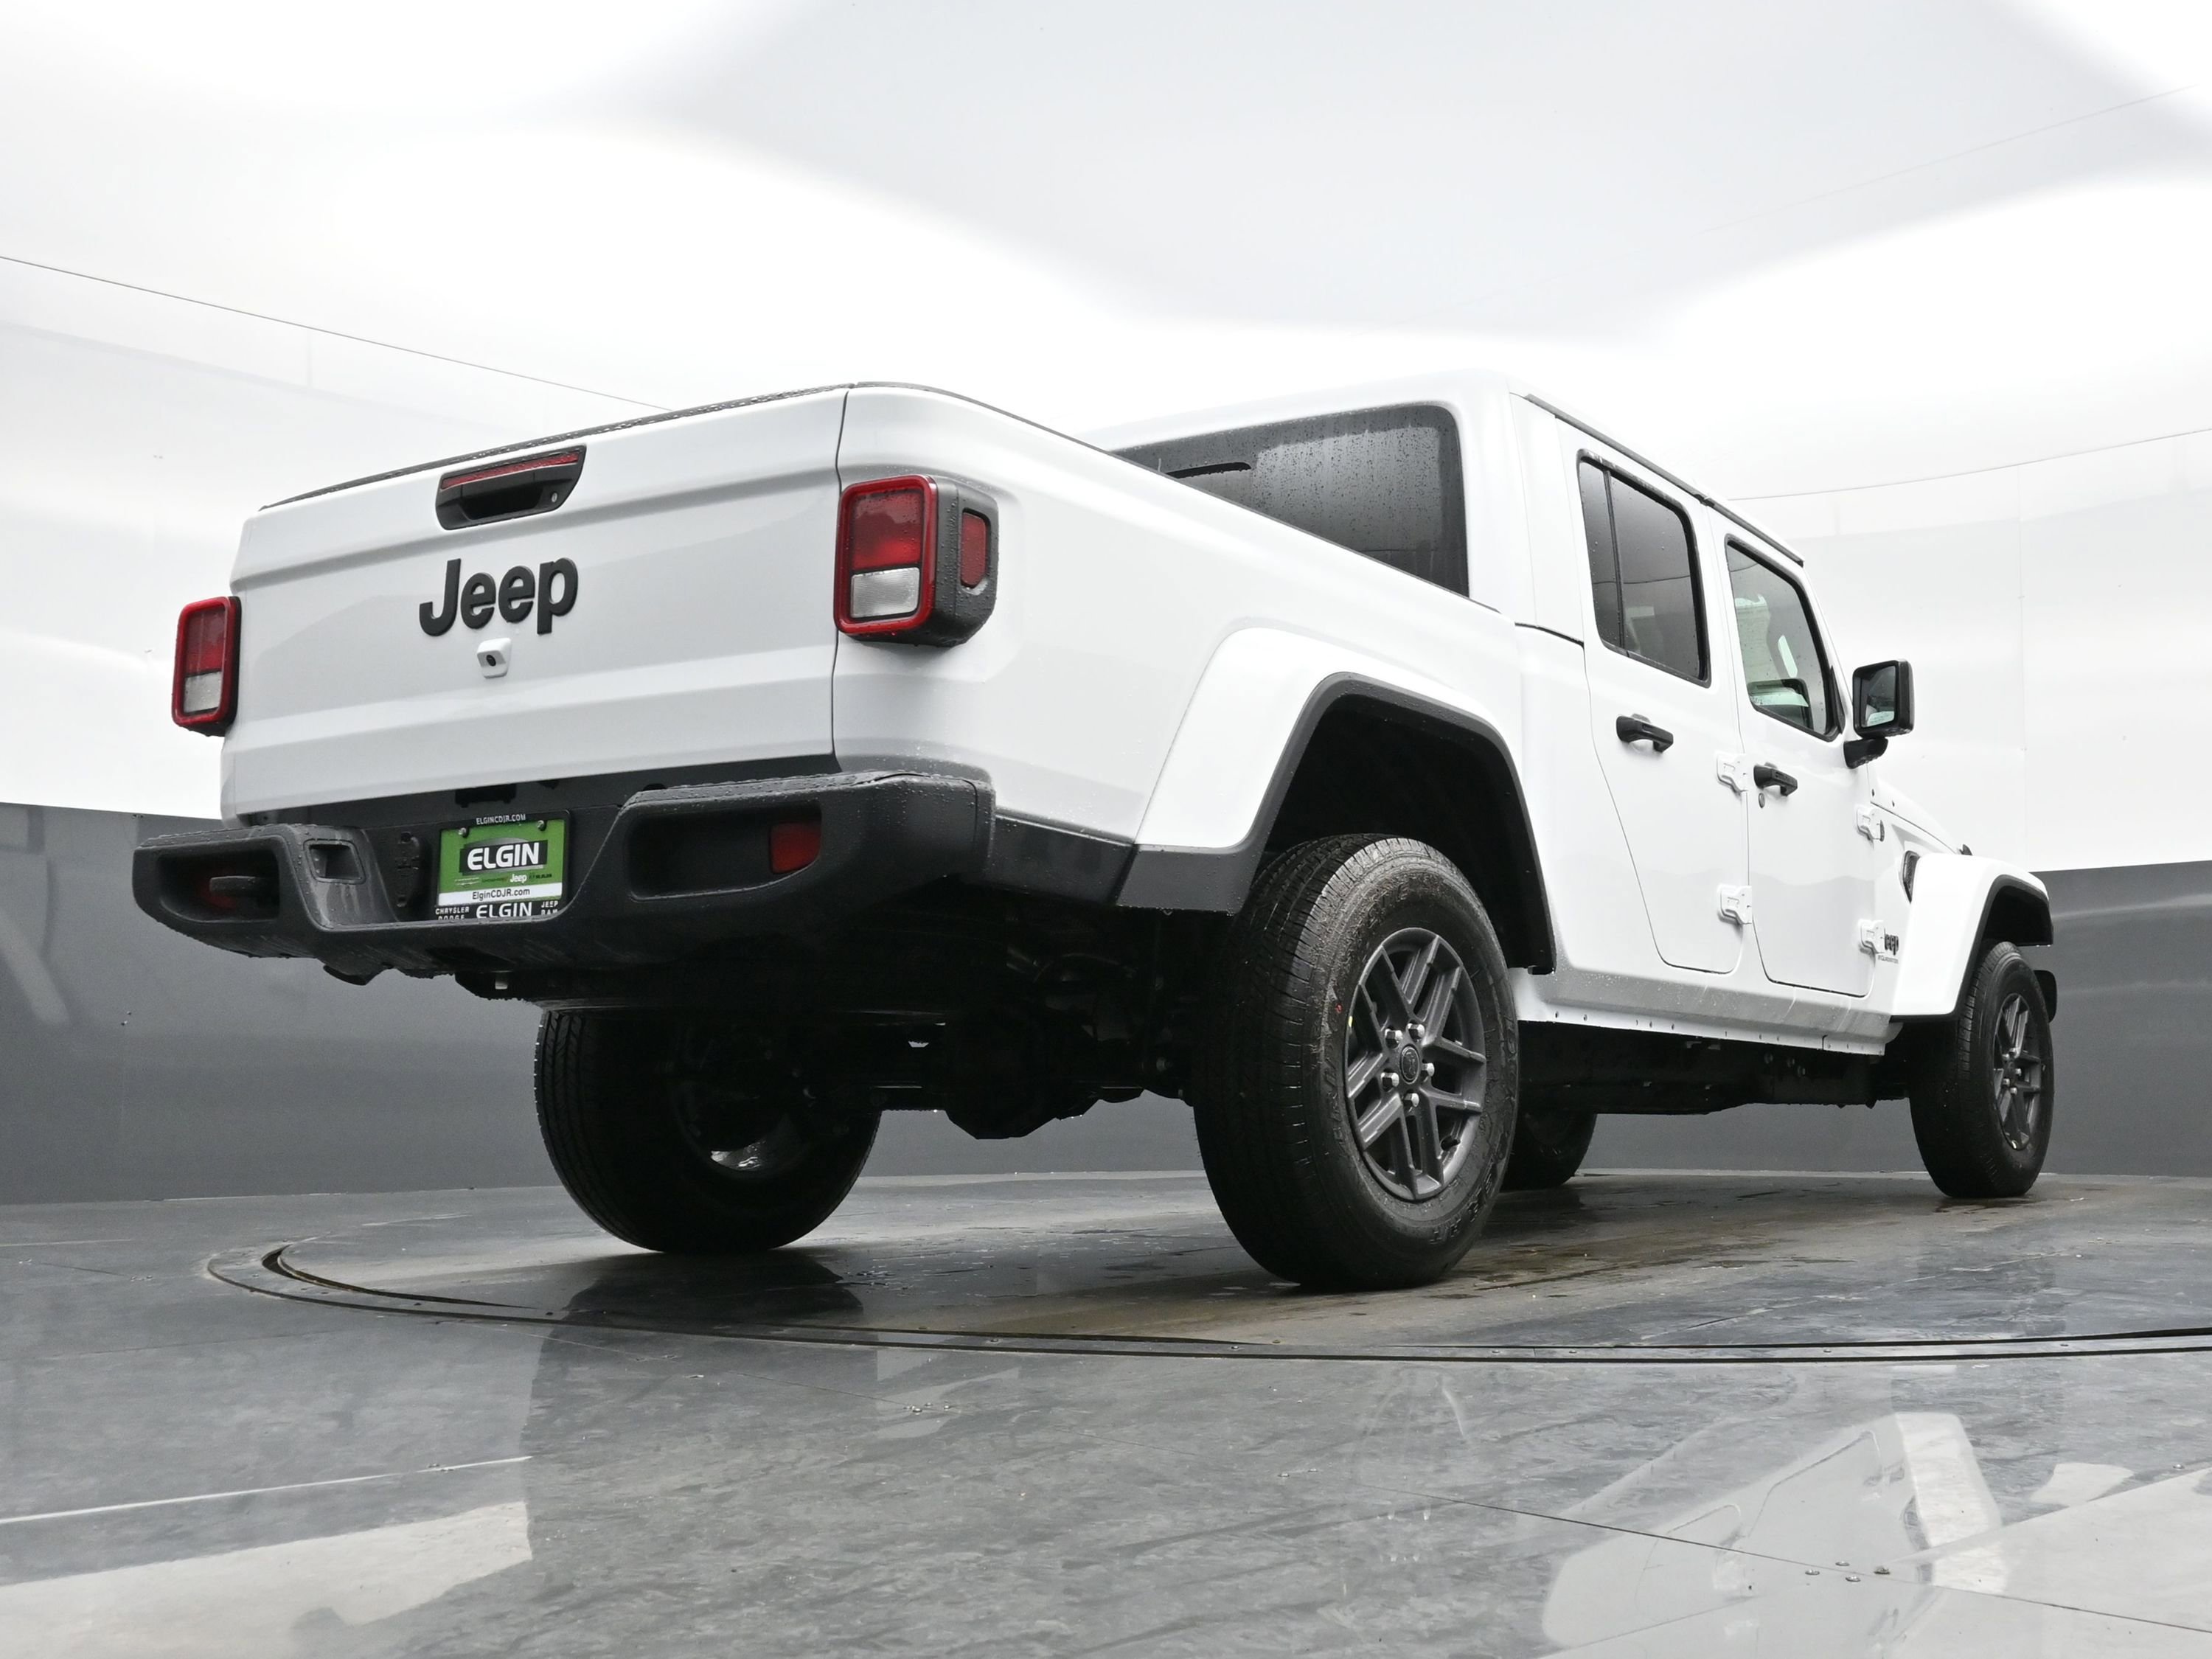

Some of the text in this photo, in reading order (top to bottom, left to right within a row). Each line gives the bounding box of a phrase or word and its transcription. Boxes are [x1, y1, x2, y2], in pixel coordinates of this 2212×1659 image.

[420, 557, 579, 636] Jeep
[476, 814, 526, 825] ELGINCDJR.COM
[467, 842, 540, 871] ELGIN
[509, 873, 527, 884] Jeep
[472, 888, 530, 901] ElginCDJR.com
[435, 906, 470, 914] CHRYSLER
[476, 902, 532, 919] ELGIN
[541, 900, 559, 908] JEEP
[1884, 933, 1899, 956] eep
